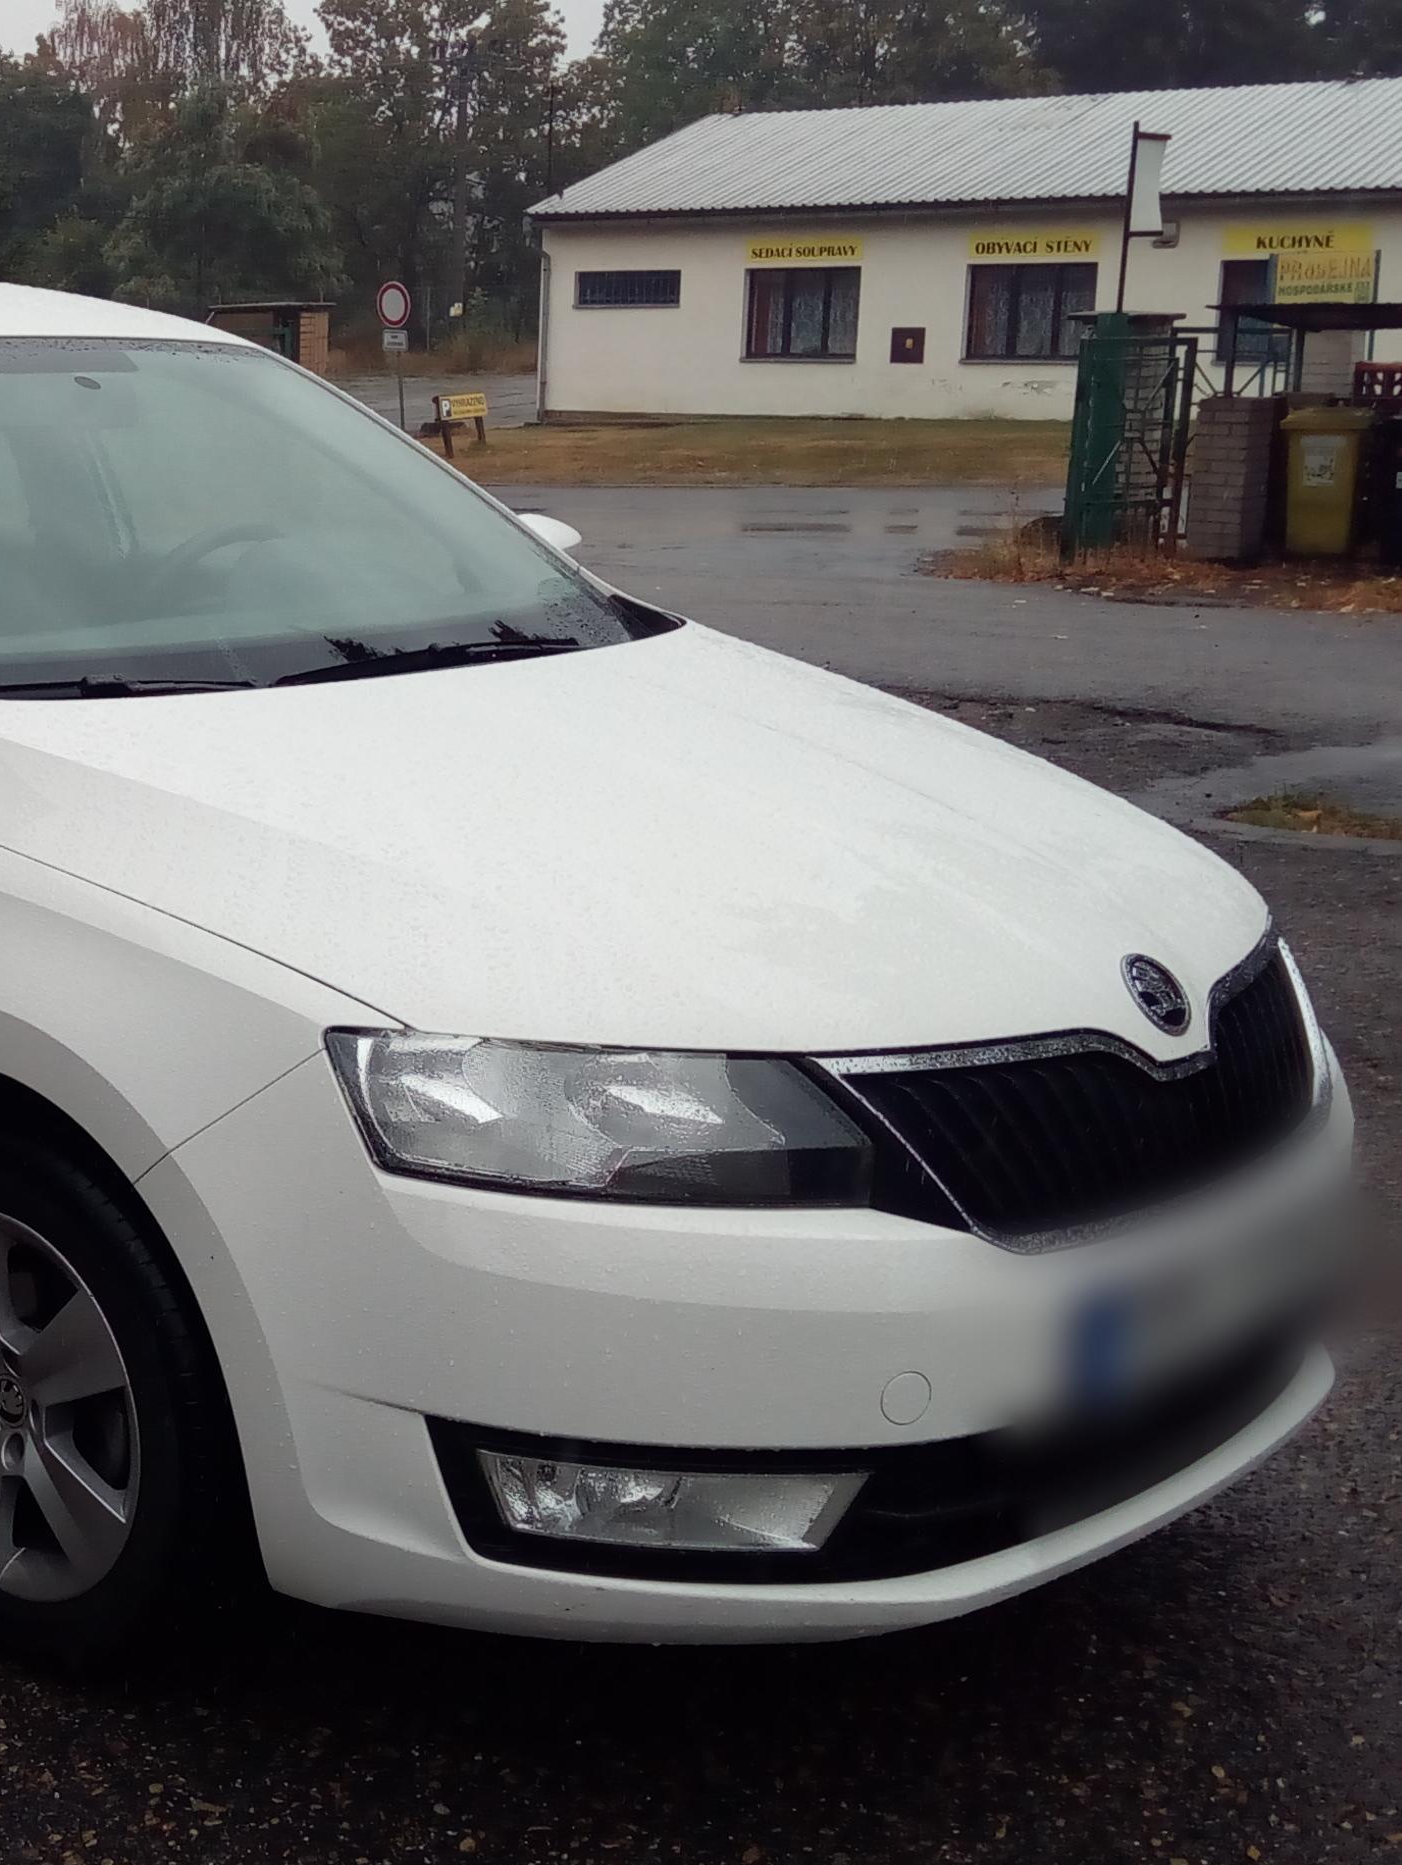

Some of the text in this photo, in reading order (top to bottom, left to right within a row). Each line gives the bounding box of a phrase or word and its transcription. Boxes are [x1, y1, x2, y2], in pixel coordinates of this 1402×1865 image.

[751, 242, 857, 259] SEDACÍ SOUPRAVY
[1045, 235, 1092, 254] STĚNY
